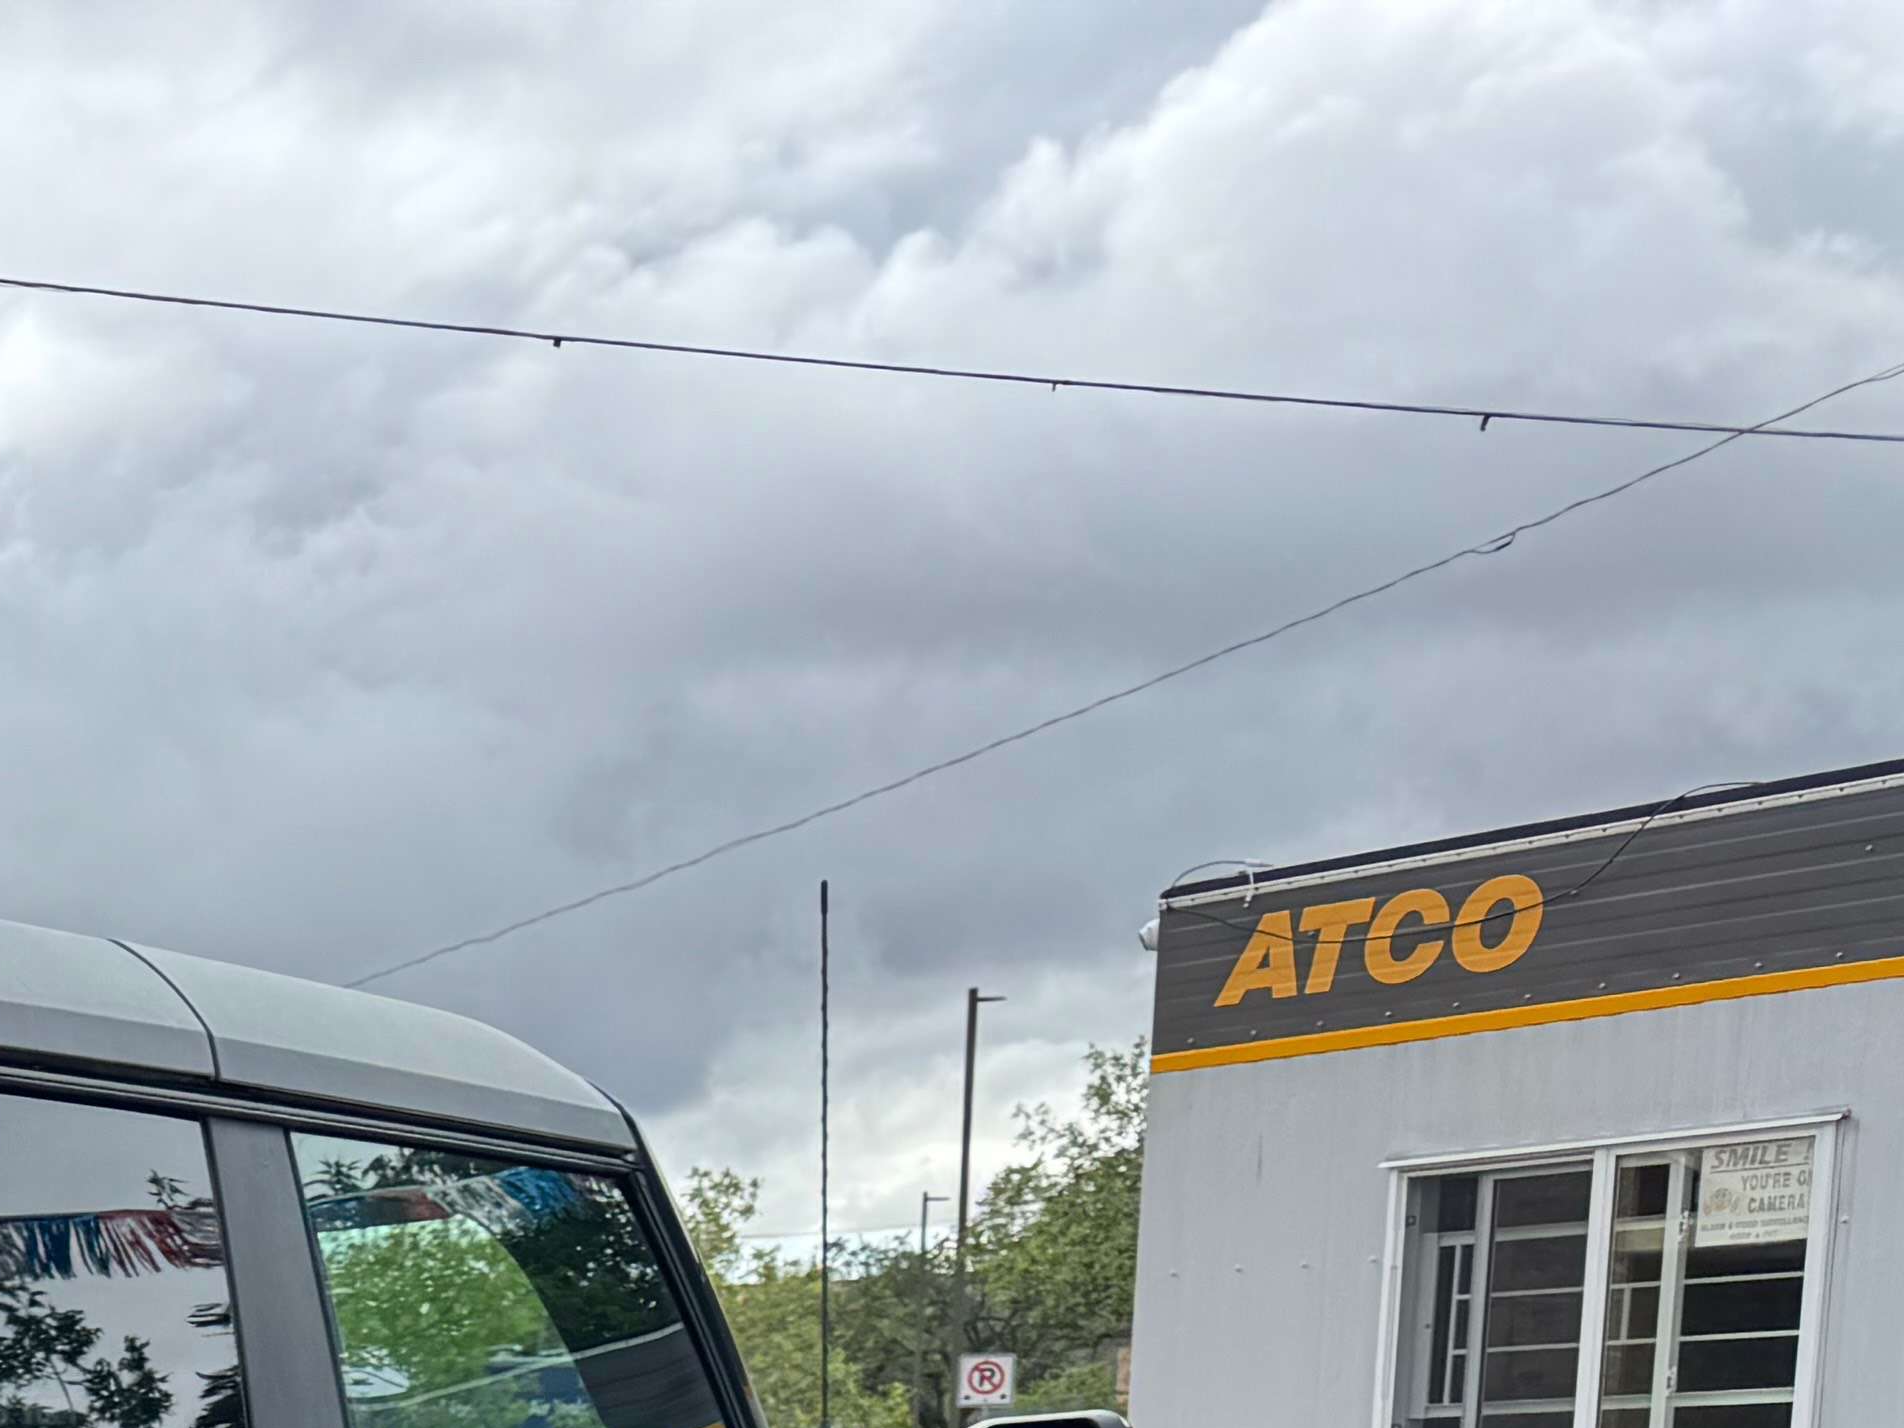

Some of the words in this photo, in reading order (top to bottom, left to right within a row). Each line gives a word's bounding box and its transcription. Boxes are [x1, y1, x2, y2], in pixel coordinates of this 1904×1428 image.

[1213, 874, 1544, 1007] ATCO
[1712, 1145, 1789, 1169] SMILE
[1741, 1172, 1791, 1191] YOU'RE
[1748, 1194, 1805, 1214] CAMERA
